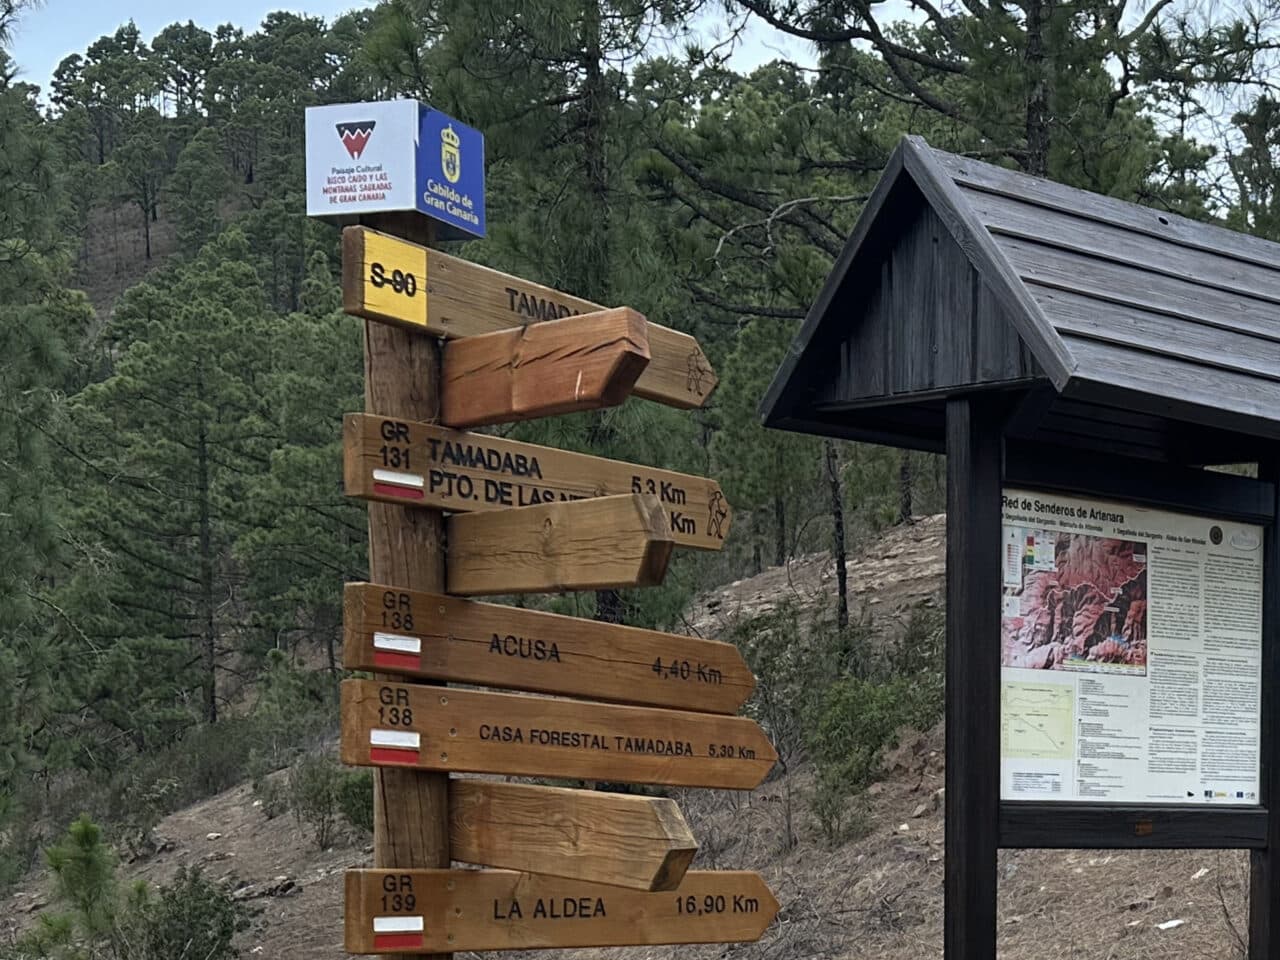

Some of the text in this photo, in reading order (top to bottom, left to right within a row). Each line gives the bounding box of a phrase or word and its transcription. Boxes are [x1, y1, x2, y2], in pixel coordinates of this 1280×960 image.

[327, 175, 346, 184] RISCO
[369, 174, 374, 182] Y
[375, 172, 388, 181] LAS
[331, 164, 383, 175] Paisaje Cultural
[329, 192, 386, 204] DE GRAN CANARIA
[359, 182, 393, 192] SAGRADAS
[427, 179, 473, 209] Cabildo de
[424, 192, 479, 225] Gran Canaria
[370, 262, 417, 297] S-90
[505, 287, 587, 321] TAMAD
[381, 420, 410, 444] GR
[380, 445, 411, 469] 131
[427, 438, 543, 479] TAMADABA
[660, 480, 686, 506] Km
[429, 470, 478, 500] PTO.
[484, 480, 513, 506] DE
[518, 485, 555, 506] LAS
[670, 511, 697, 536] Km
[1001, 496, 1124, 524] Red de Senderos de Artenara
[382, 591, 411, 610] GR
[382, 612, 414, 631] 138
[489, 633, 723, 685] ACUSA 4,40 Km
[379, 686, 410, 706] GR
[378, 708, 413, 727] 138
[479, 724, 524, 743] CASA
[530, 729, 609, 750] FORESTAL
[615, 736, 693, 756] TAMADABA
[738, 746, 756, 760] Km
[382, 874, 413, 892] GR
[379, 894, 416, 913] 139
[493, 894, 760, 920] LA ALDEA 16,90 Km
